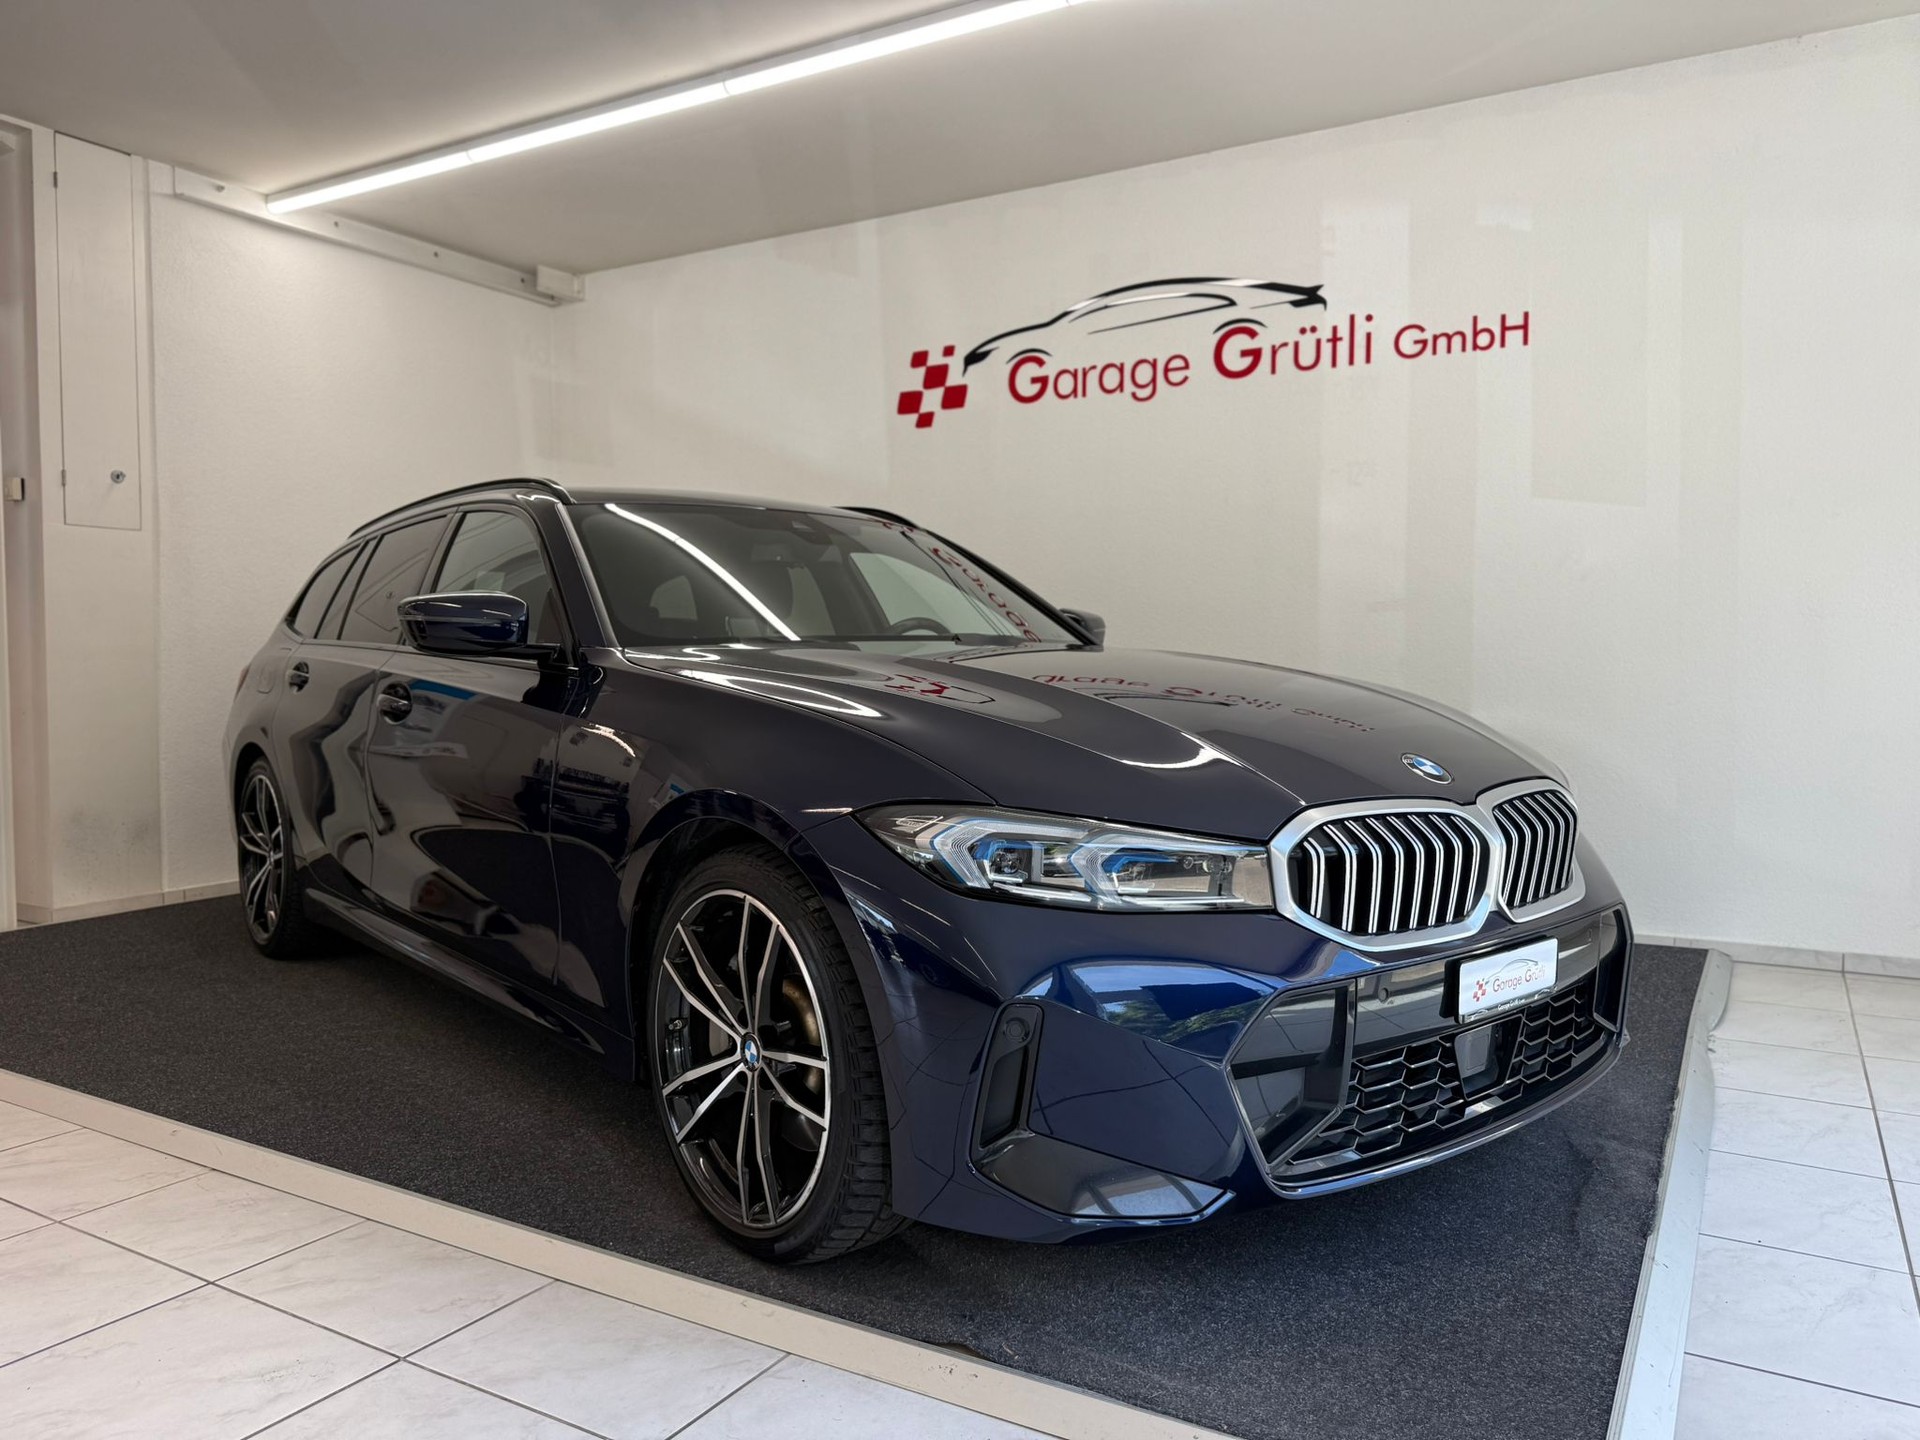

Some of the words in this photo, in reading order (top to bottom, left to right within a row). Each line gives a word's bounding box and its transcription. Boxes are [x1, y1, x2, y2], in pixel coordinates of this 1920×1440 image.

[1008, 353, 1192, 406] Garage
[1213, 313, 1376, 381] Grütli
[1393, 311, 1531, 361] GmbH
[1492, 977, 1522, 993] Garage
